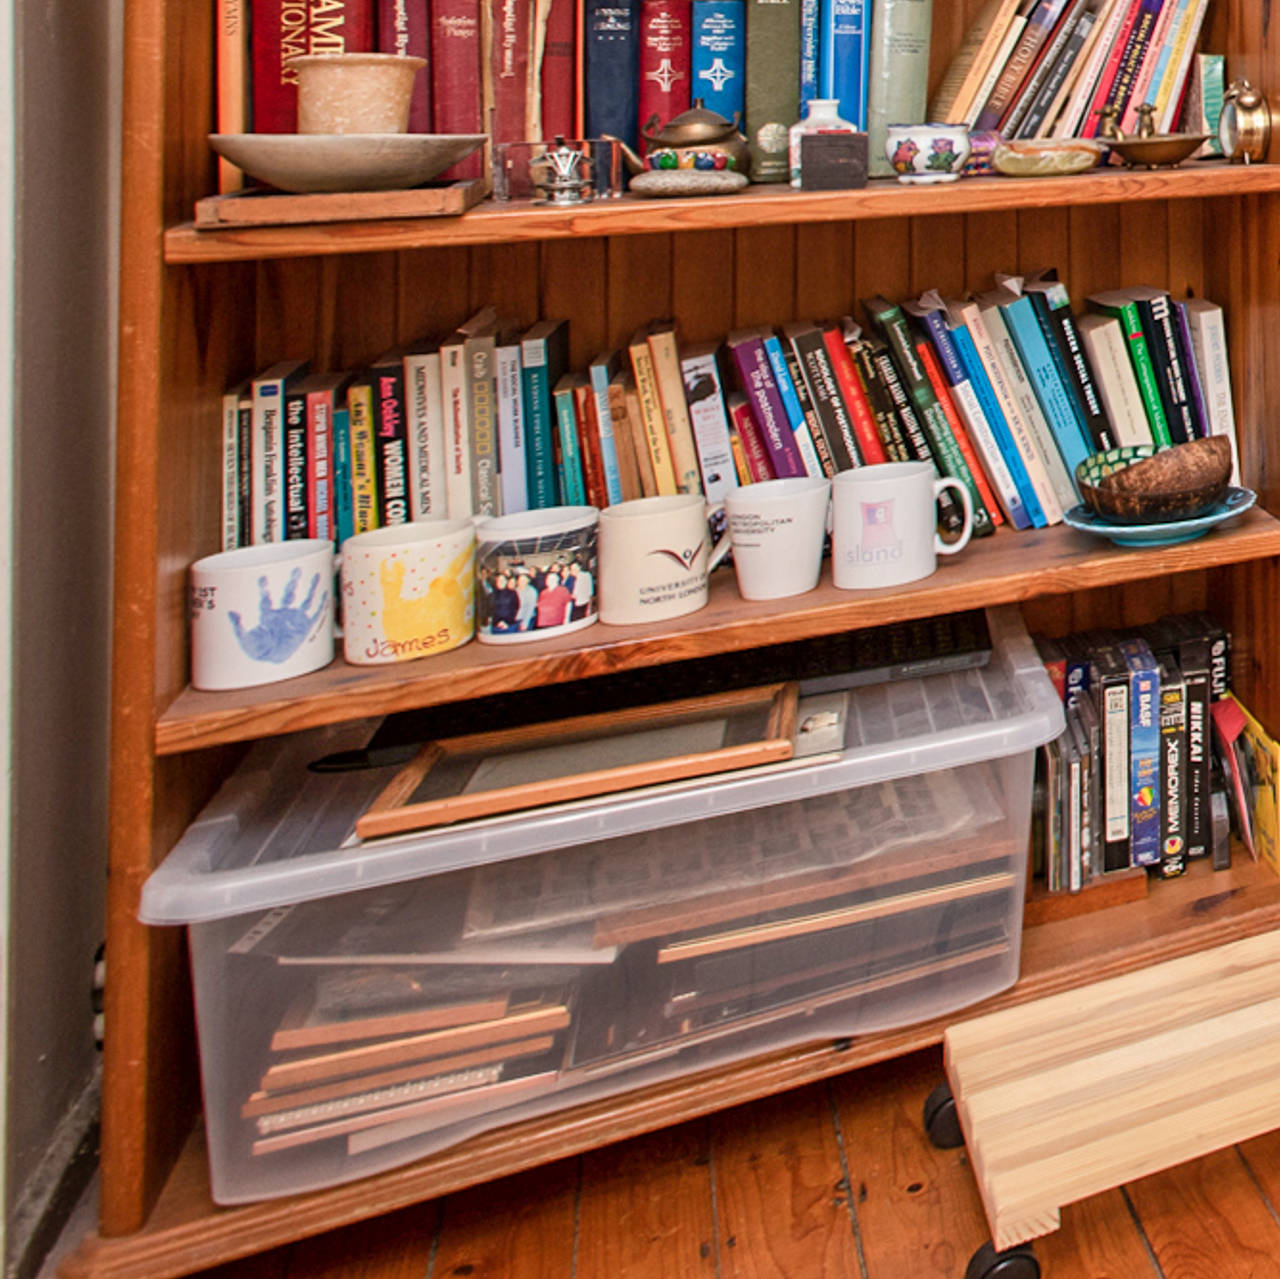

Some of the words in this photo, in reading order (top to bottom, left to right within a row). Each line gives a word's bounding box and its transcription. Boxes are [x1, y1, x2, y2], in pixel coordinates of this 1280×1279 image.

[835, 5, 863, 16] Bible
[1135, 12, 1153, 43] SOCIAL
[1008, 33, 1039, 75] HOLY
[1125, 42, 1143, 74] POLICY
[987, 71, 1017, 111] BIBLE
[931, 317, 941, 328] AN
[752, 348, 765, 361] the
[756, 360, 771, 381] idea
[1060, 317, 1080, 354] MODERN
[1071, 352, 1090, 385] SOCIAL
[1081, 382, 1101, 416] THEORY
[379, 375, 398, 399] Ann
[414, 365, 428, 418] MIDWIVES
[749, 368, 765, 389] the
[762, 379, 774, 390] of
[803, 351, 821, 378] SCOTT
[812, 377, 829, 402] LASH
[810, 348, 838, 397] SOCIOLOGY
[828, 394, 842, 408] OF
[261, 409, 276, 451] Benjamin
[286, 400, 303, 424] the
[376, 398, 400, 438] Oakley
[753, 387, 784, 452] postmodern
[960, 382, 980, 411] Social
[970, 408, 1003, 465] Construction
[416, 420, 428, 443] AND
[264, 453, 277, 496] Franklin
[286, 428, 304, 511] intellectual
[381, 438, 406, 498] WOMEN
[417, 444, 431, 489] MEDICAL
[476, 458, 491, 500] Classical
[419, 490, 432, 515] MEN
[639, 575, 698, 594] UNIVERSITY
[639, 593, 675, 605] NORTH
[366, 628, 450, 658] James
[1211, 656, 1225, 694] FUJI
[1066, 685, 1081, 710] FU
[1138, 693, 1151, 727] BASF
[1189, 701, 1203, 762] NIKKAI
[1166, 739, 1179, 833] MEMOREX
